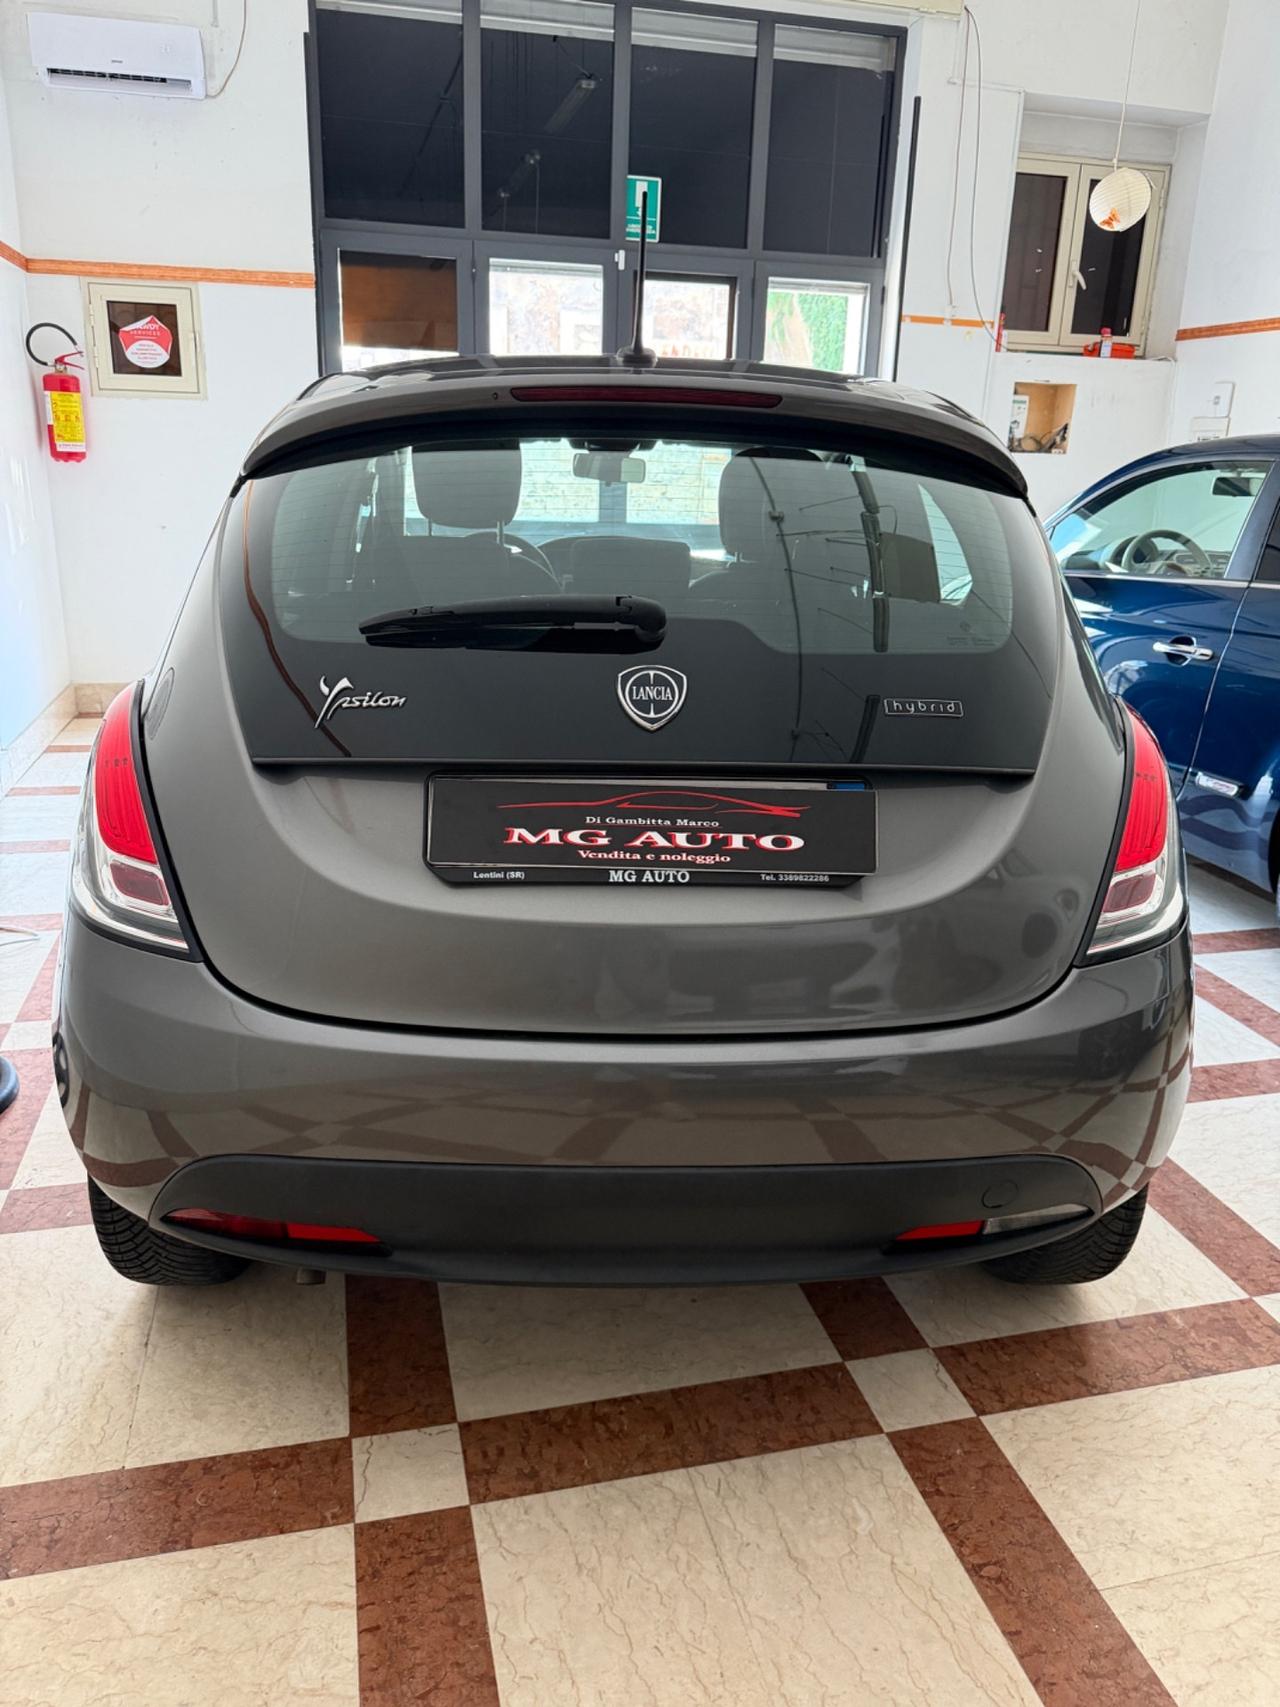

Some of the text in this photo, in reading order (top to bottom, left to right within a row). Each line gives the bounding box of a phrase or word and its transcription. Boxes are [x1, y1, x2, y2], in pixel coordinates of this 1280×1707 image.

[632, 685, 673, 701] LANCIA
[314, 675, 408, 729] Ypsilon
[893, 700, 955, 713] hybrid
[585, 816, 719, 827] Di Gambitta Marco
[503, 827, 805, 852] MG AUTO
[578, 849, 732, 865] Vendita e noleggio
[473, 871, 525, 880] Lentini (SR)
[609, 870, 690, 883] MG AUTO
[760, 873, 776, 882] Tel.
